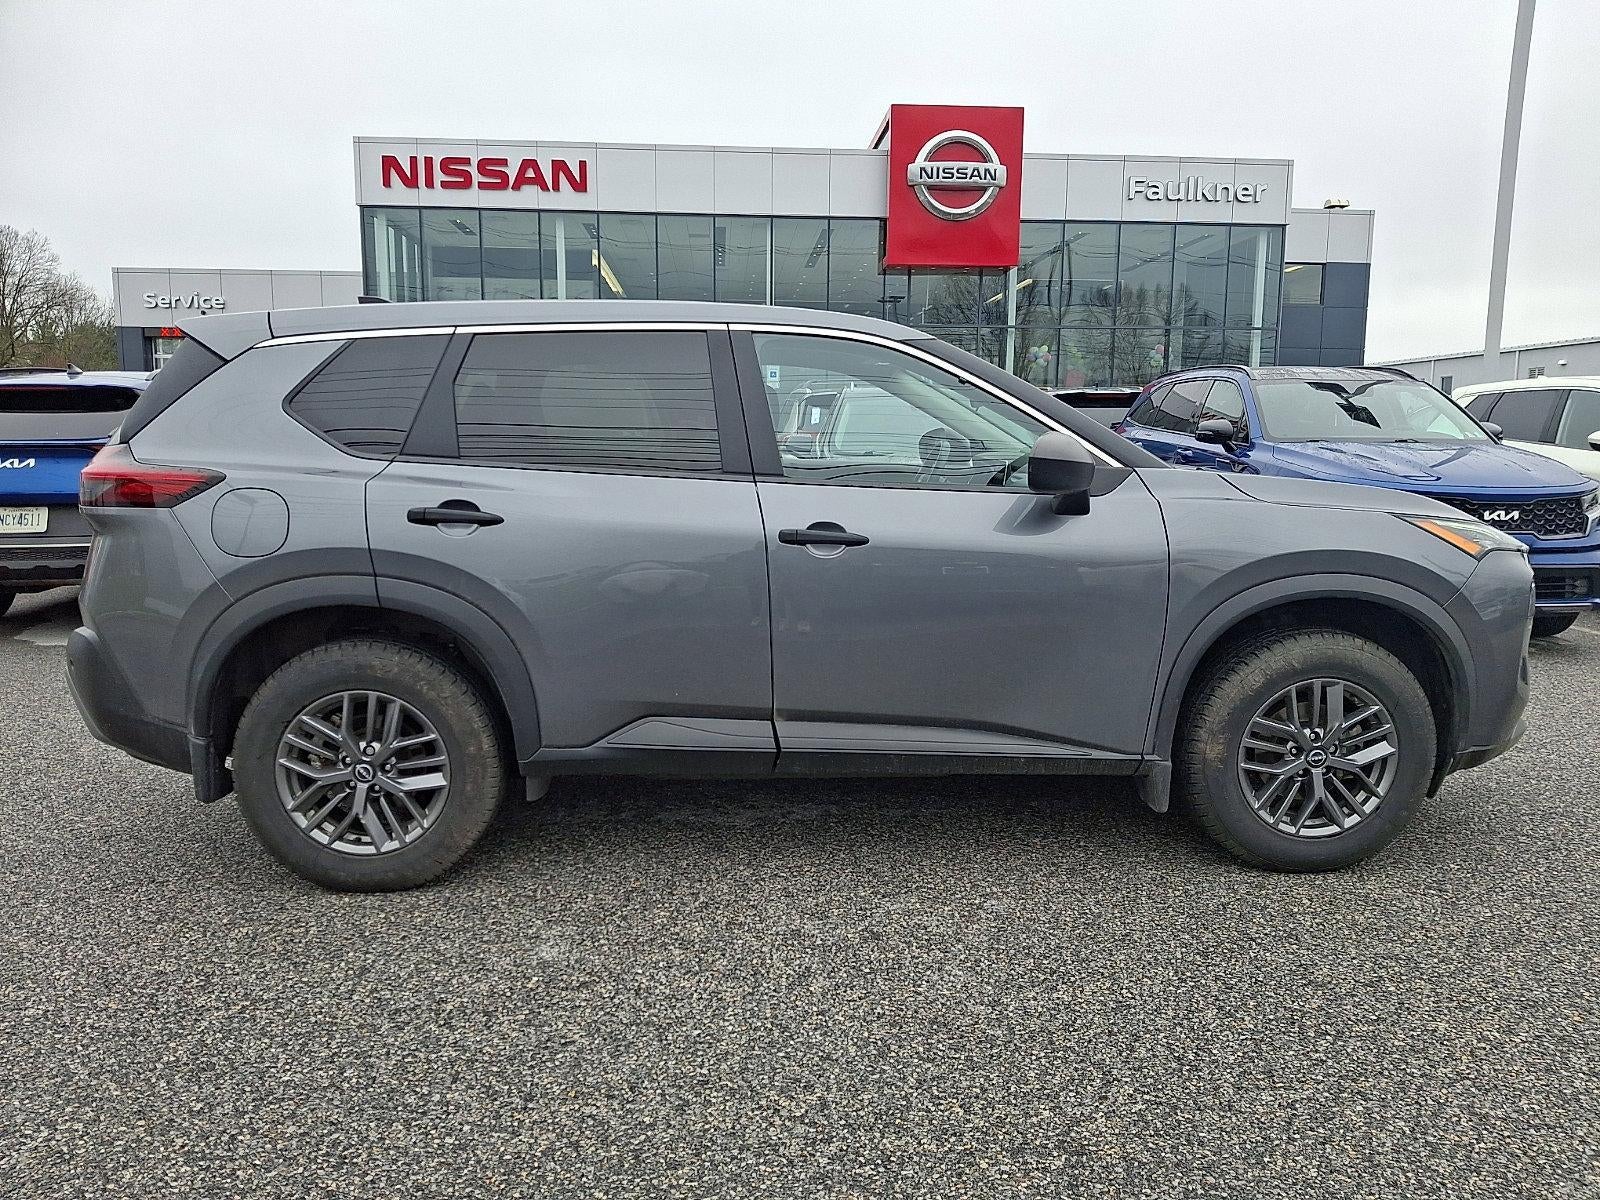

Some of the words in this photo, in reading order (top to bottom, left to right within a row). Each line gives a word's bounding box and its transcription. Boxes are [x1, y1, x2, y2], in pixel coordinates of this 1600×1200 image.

[381, 154, 588, 193] NISSAN
[919, 166, 998, 182] NISSAN
[1128, 175, 1268, 203] Faulkner
[142, 290, 225, 309] Service
[1483, 510, 1520, 521] KIA
